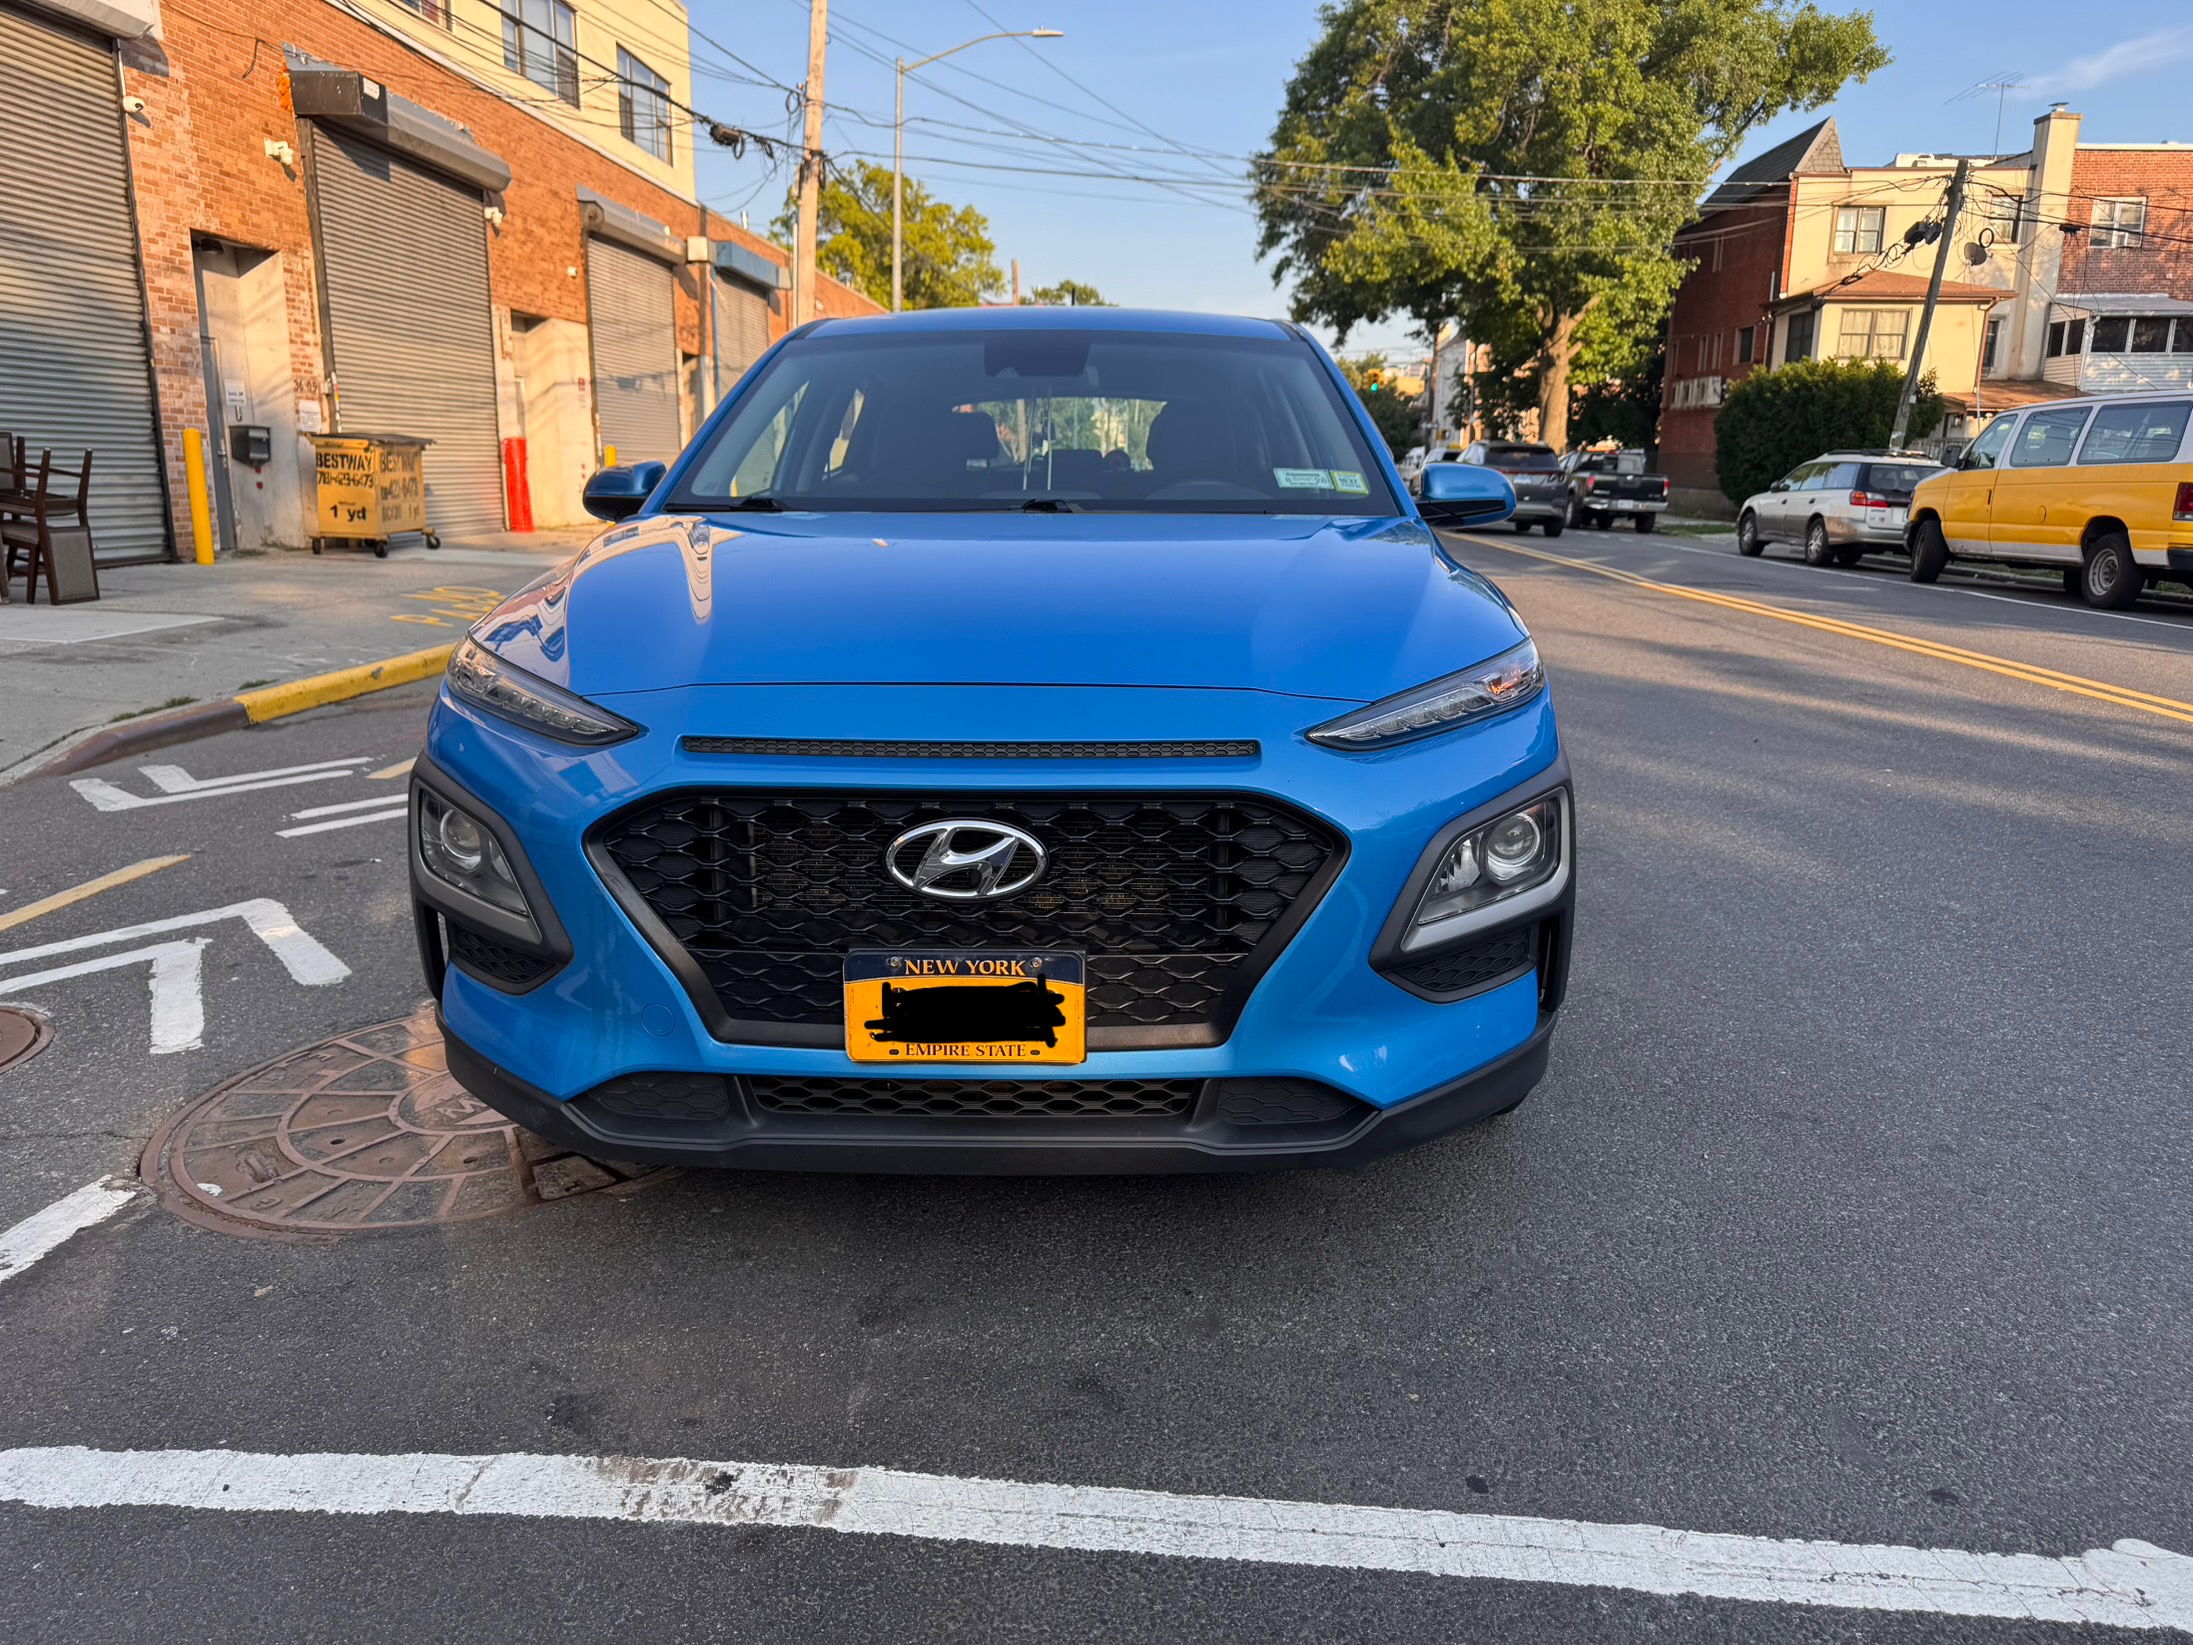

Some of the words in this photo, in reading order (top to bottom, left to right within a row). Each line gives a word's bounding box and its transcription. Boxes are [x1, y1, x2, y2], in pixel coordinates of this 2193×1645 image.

[316, 452, 372, 472] BESTWAY
[330, 504, 338, 518] 1
[347, 506, 366, 522] yd
[905, 959, 960, 975] NEW
[966, 959, 1026, 976] YORK
[905, 1043, 970, 1057] EMPIRE
[976, 1044, 1026, 1057] STATE
